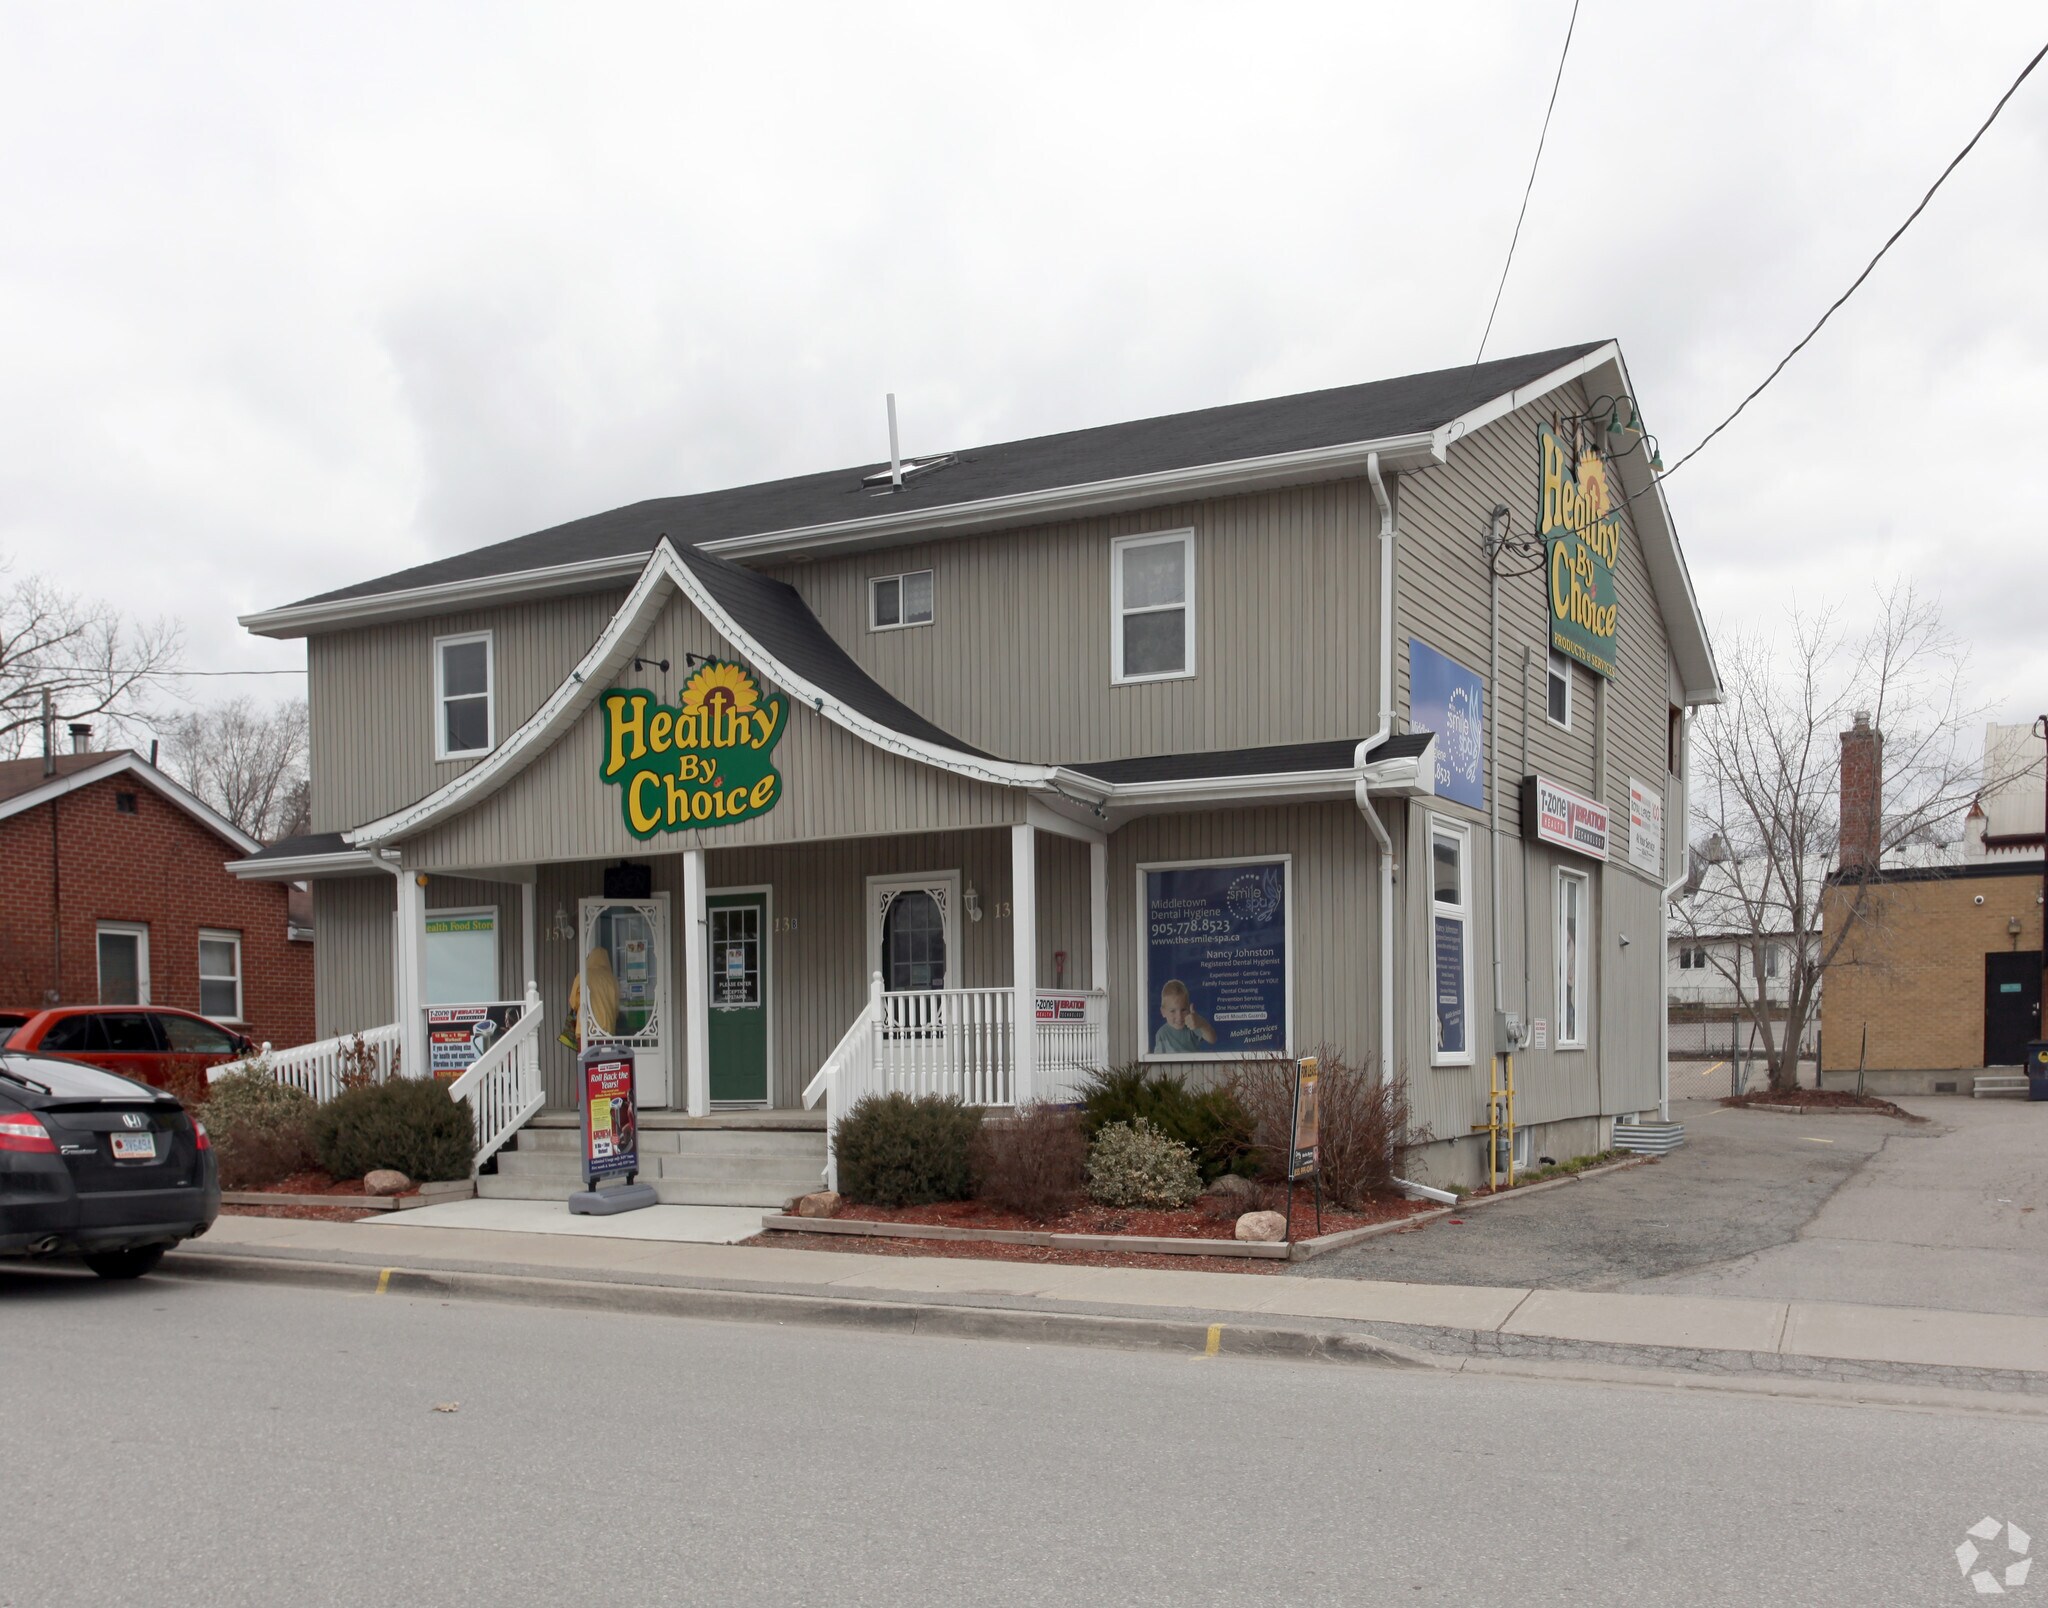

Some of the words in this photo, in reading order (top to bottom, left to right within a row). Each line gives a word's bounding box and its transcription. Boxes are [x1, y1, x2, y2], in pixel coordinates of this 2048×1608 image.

[1541, 433, 1619, 568] Healthy
[1576, 543, 1594, 587] By
[1552, 540, 1616, 637] Choice
[1554, 632, 1586, 660] PRODUCTS
[1449, 708, 1469, 735] smile
[606, 691, 779, 776] Healthy
[1460, 733, 1472, 760] spa
[679, 754, 717, 784] By
[629, 770, 775, 833] Choice
[1567, 800, 1606, 839] VIBRATION
[1544, 817, 1563, 832] HEALTH
[1575, 828, 1604, 848] TECHNOLOGY
[1230, 884, 1261, 901] smile
[1152, 899, 1207, 909] Middletown
[1246, 897, 1267, 912] spa
[1152, 910, 1181, 920] Dental
[1183, 907, 1221, 920] Hygiene
[426, 922, 448, 933] ealth
[450, 921, 471, 931] Food
[1151, 918, 1230, 937] 905.778.8523
[1151, 933, 1240, 946] www.the-smile-spa.ca
[1206, 951, 1232, 960] Nancy
[1234, 949, 1274, 958] Johnston
[1200, 961, 1232, 969] Registered
[1252, 959, 1280, 967] Hygienist
[451, 1008, 487, 1021] VIBRATION
[1054, 999, 1085, 1018] VIBRATION
[1230, 1029, 1252, 1038] Mobile
[1252, 1025, 1278, 1034] Services
[1244, 1034, 1273, 1044] Available
[590, 1074, 603, 1083] Roll
[604, 1073, 618, 1081] Back
[618, 1072, 629, 1080] the
[602, 1081, 619, 1090] Years!
